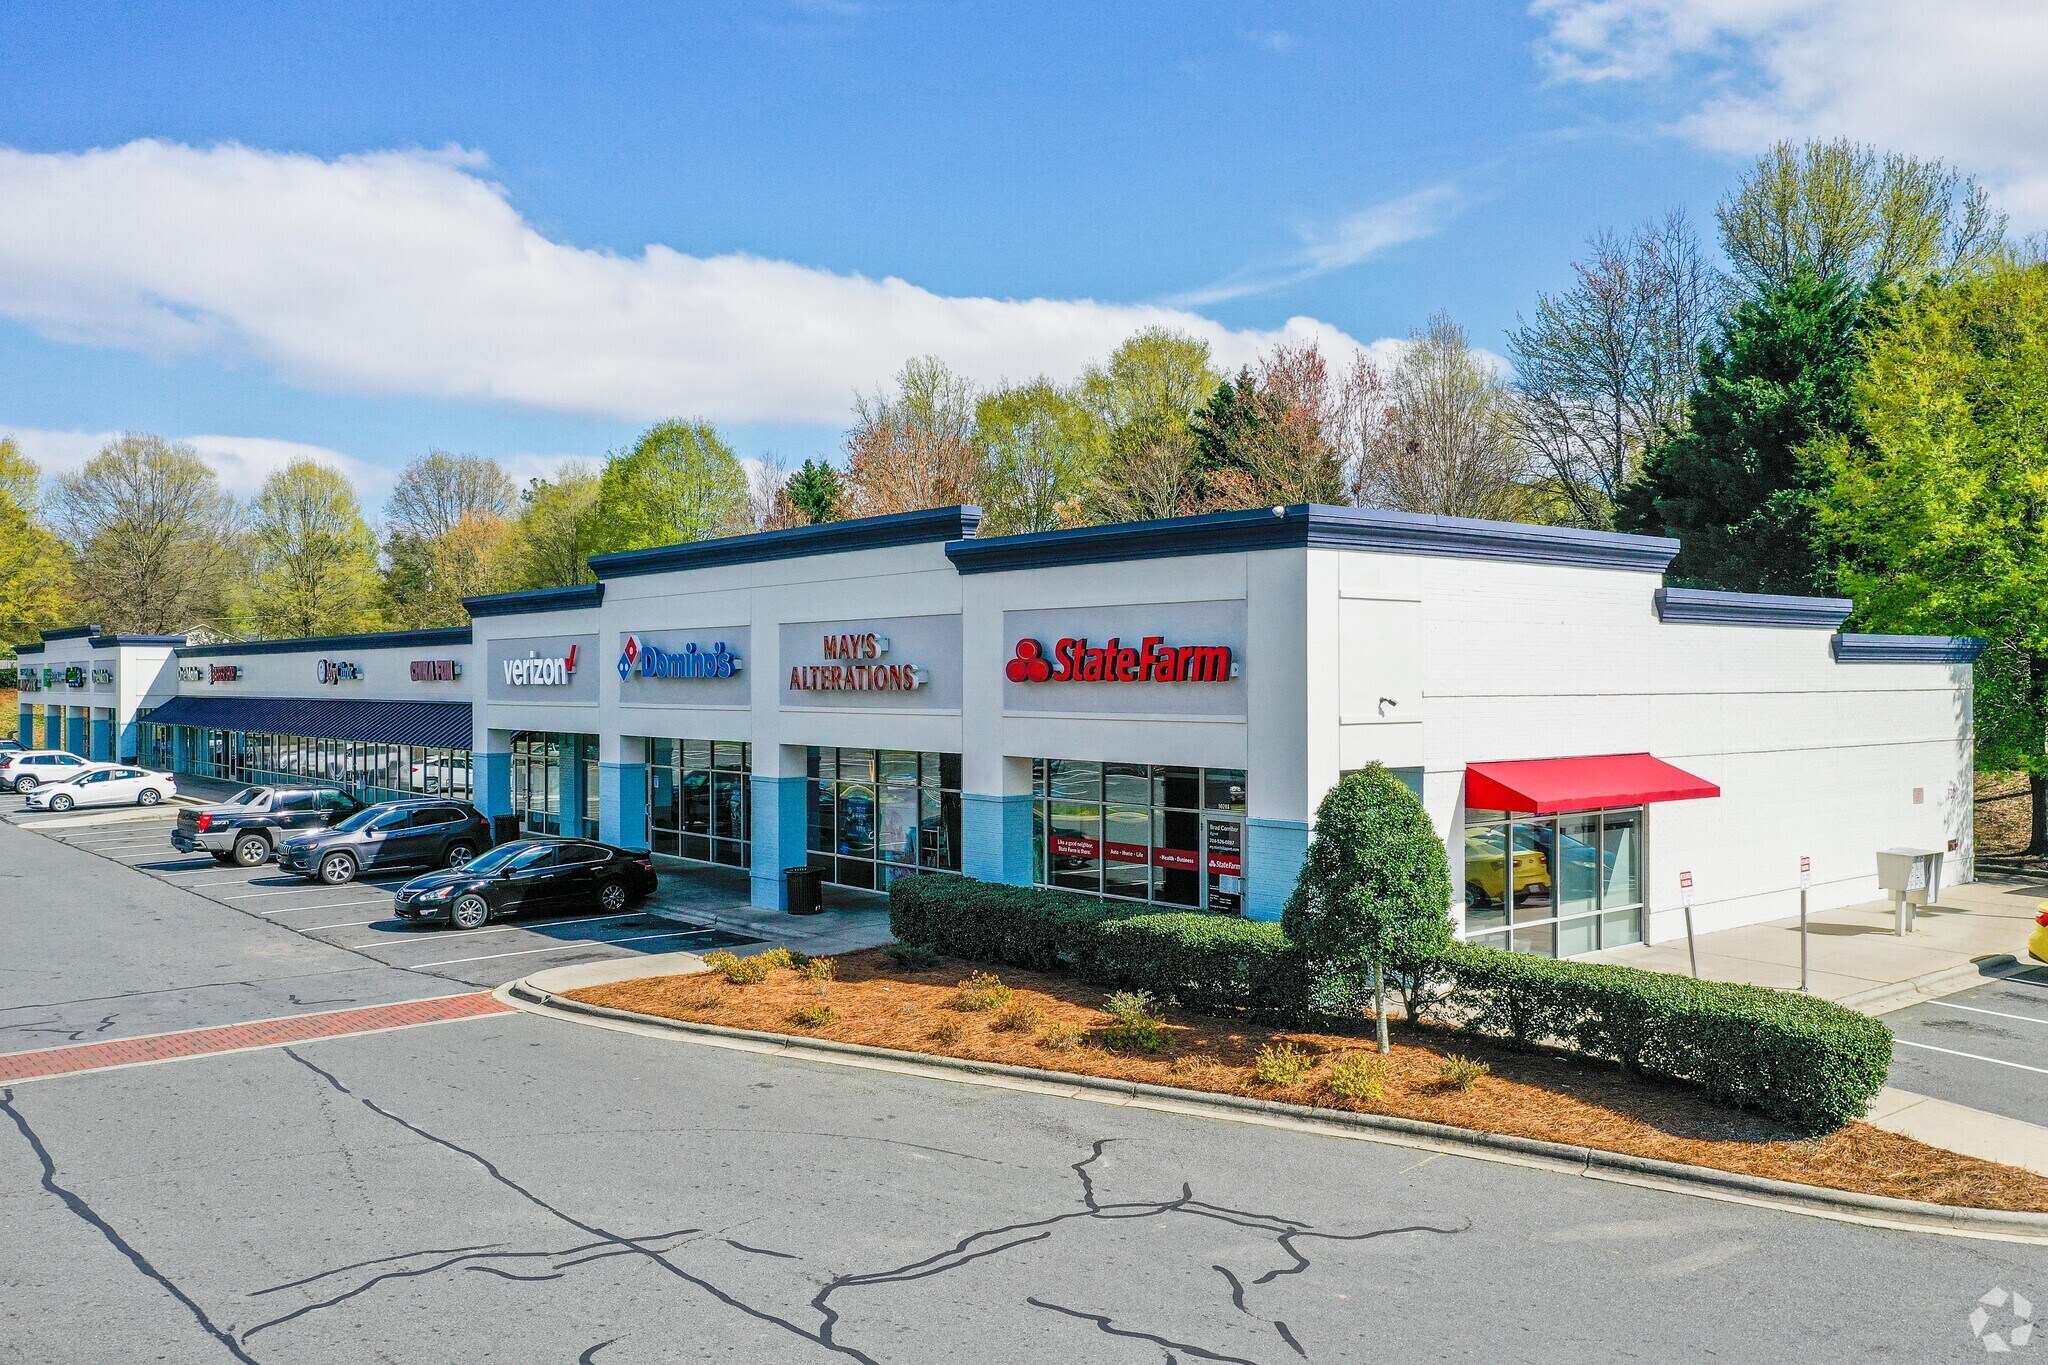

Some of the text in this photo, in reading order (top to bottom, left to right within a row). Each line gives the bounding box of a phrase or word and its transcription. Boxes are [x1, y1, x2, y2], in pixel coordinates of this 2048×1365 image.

[641, 641, 734, 679] Domino's
[823, 632, 879, 660] MAY'S
[504, 650, 567, 685] verizon
[789, 664, 917, 691] ALTERATIONS
[1176, 856, 1194, 864] Business
